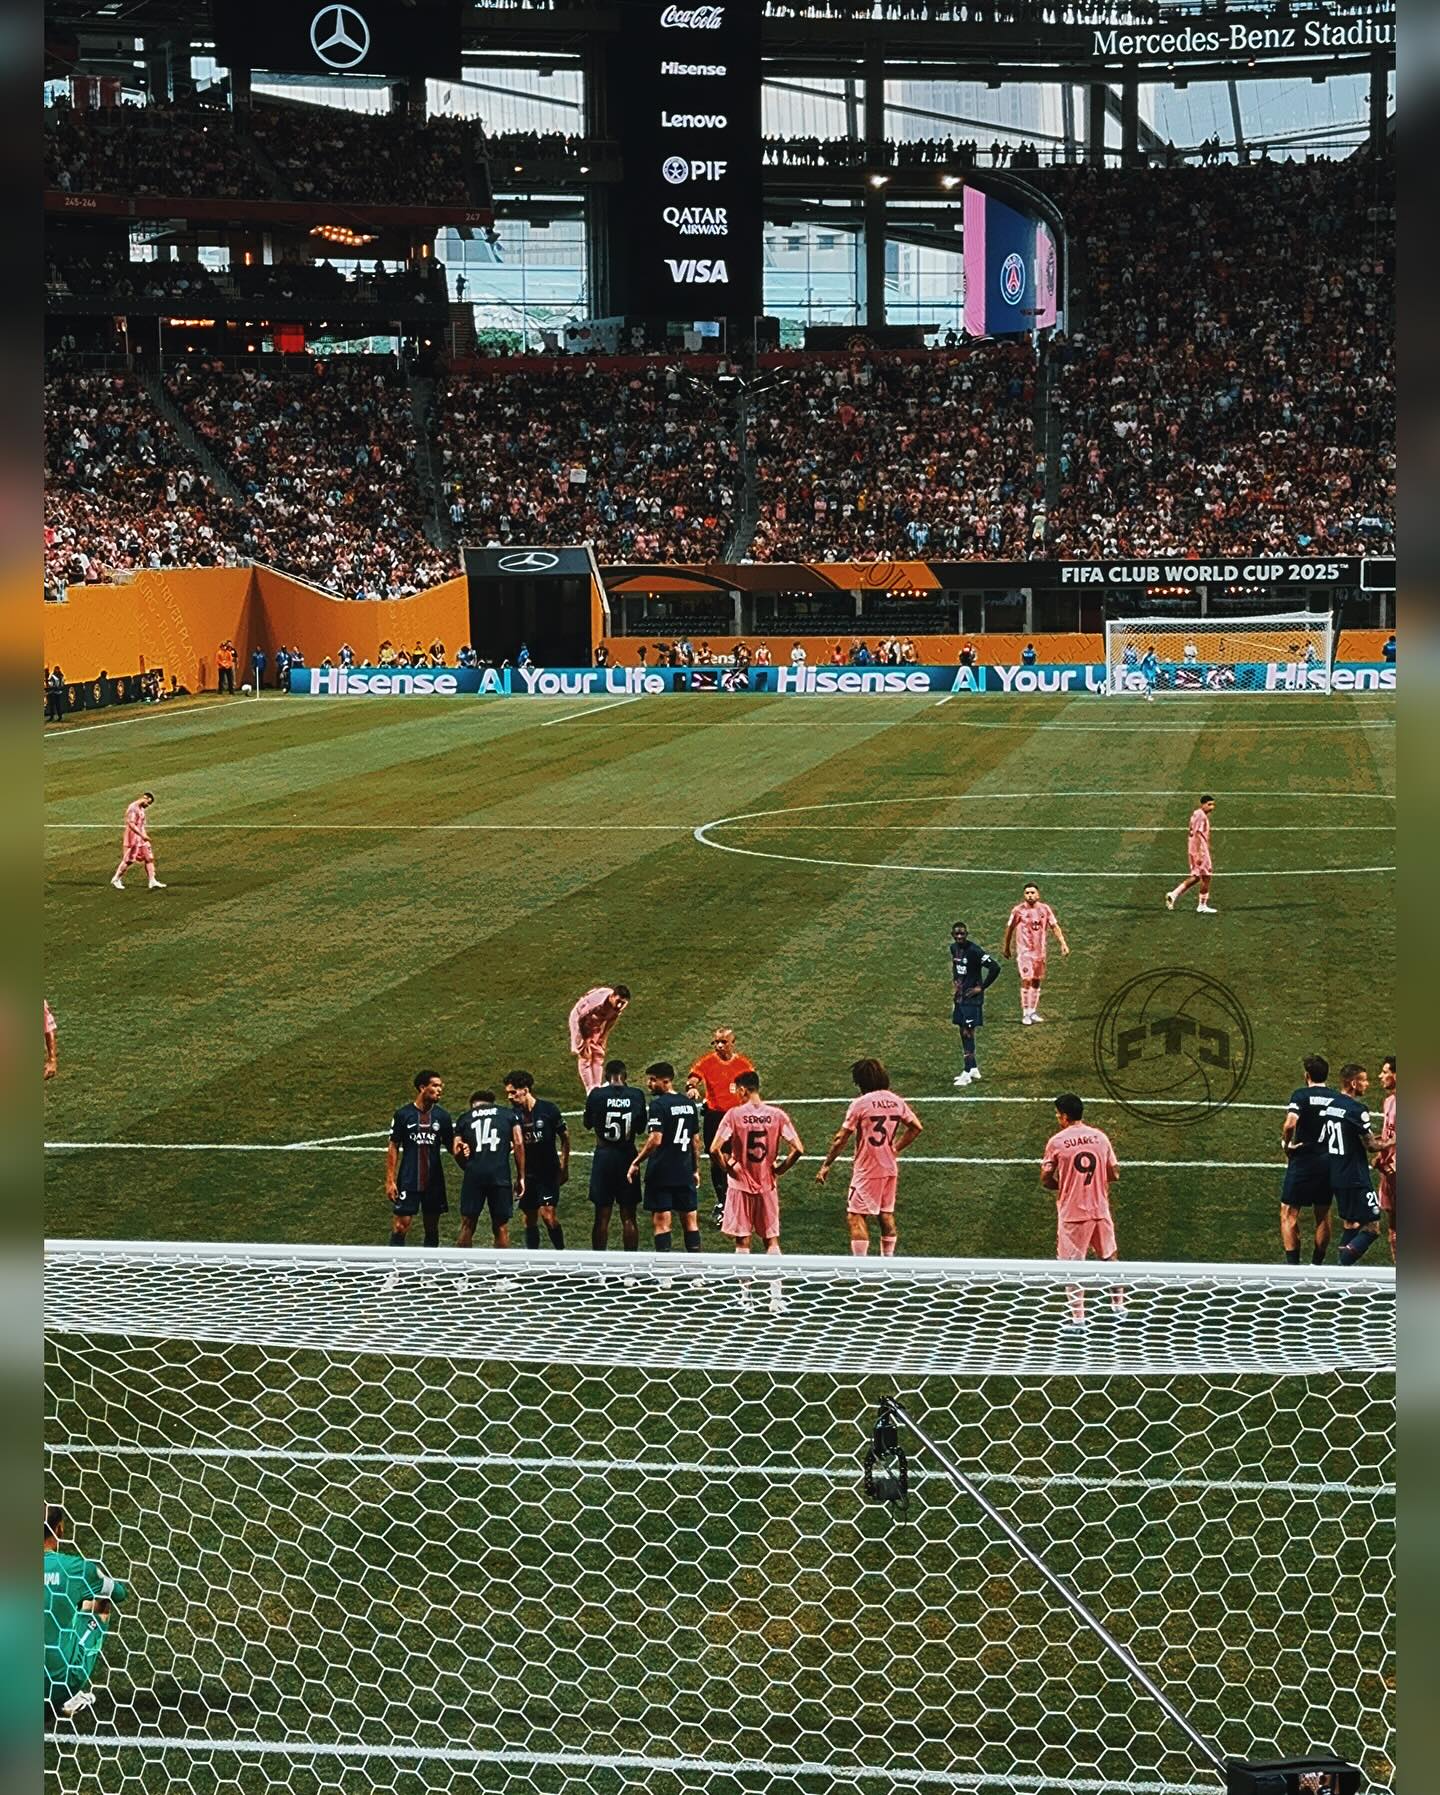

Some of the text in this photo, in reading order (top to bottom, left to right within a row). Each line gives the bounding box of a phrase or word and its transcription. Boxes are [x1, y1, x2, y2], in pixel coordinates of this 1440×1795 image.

[1092, 17, 1396, 56] Mercedes-Benz Stadiu
[661, 61, 727, 76] Hisense
[661, 110, 727, 128] Lenovo
[690, 160, 728, 181] PIF
[65, 197, 96, 208] 245-246
[663, 206, 728, 227] QATAR
[679, 224, 728, 236] AIRWAYS
[663, 259, 729, 283] VISA
[1061, 567, 1104, 583] FIFA
[1108, 566, 1160, 583] CLUB
[1164, 565, 1239, 582] WORLD
[1242, 564, 1284, 581] CUP
[310, 668, 665, 694] Hisense AI Your Life
[776, 666, 930, 693] Hisense
[951, 666, 986, 693] AI
[993, 665, 1077, 693] Your
[606, 1098, 631, 1108] PACHO
[604, 1111, 633, 1142] 51
[743, 1115, 772, 1124] SERGIO
[867, 1115, 901, 1147] 37
[470, 1117, 501, 1152] 14
[673, 1117, 691, 1152] 4
[746, 1130, 768, 1163] 5
[1326, 1119, 1345, 1155] 21
[1073, 1151, 1097, 1186] 9
